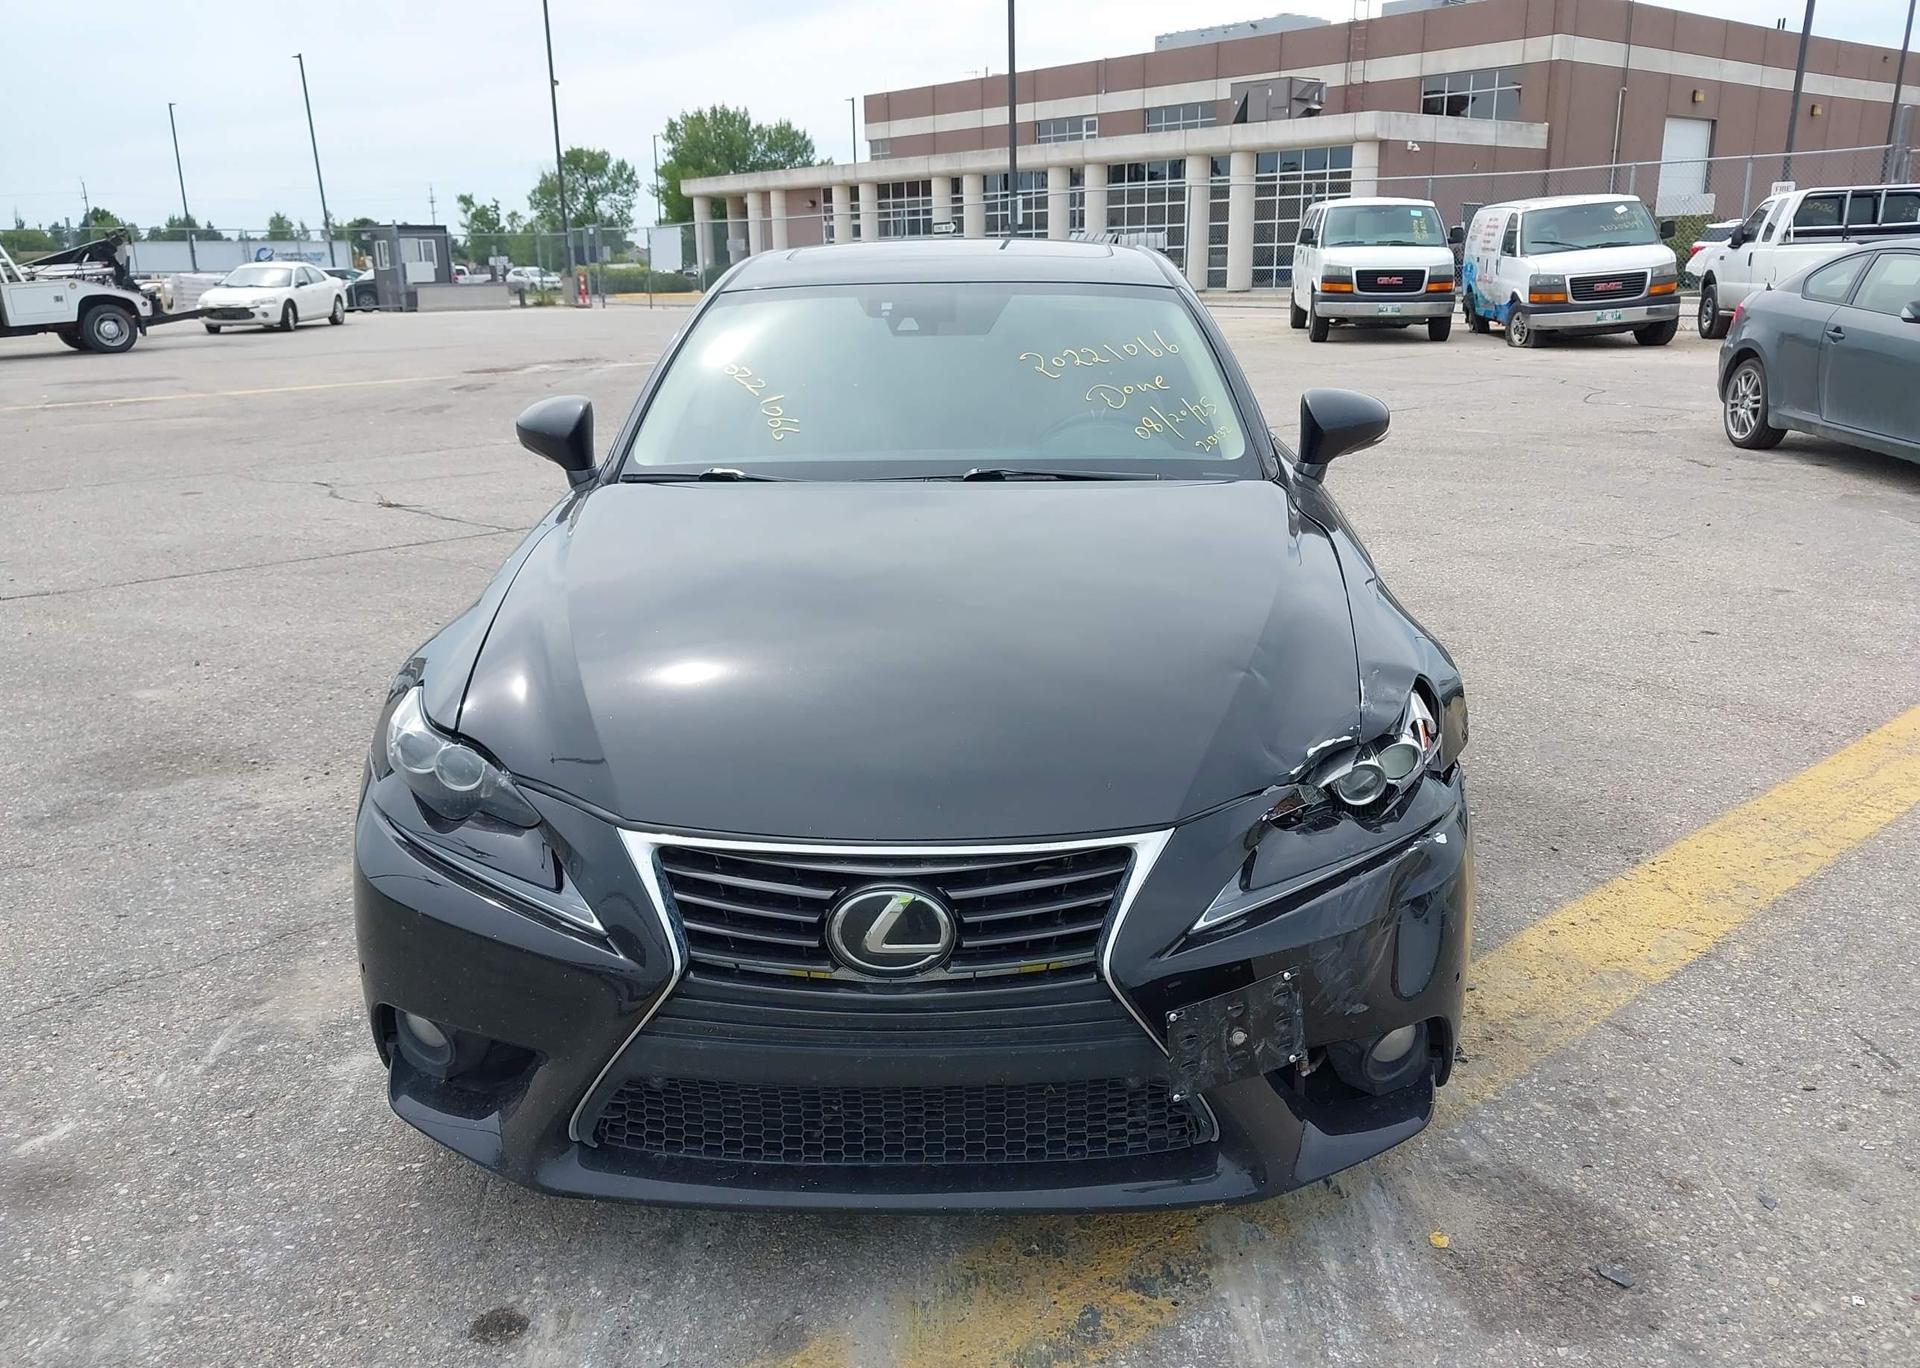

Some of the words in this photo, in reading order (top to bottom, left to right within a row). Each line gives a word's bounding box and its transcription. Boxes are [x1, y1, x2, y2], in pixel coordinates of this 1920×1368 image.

[1593, 282, 1623, 292] GMC
[1019, 329, 1180, 379] 20221066
[1085, 374, 1171, 409] Done
